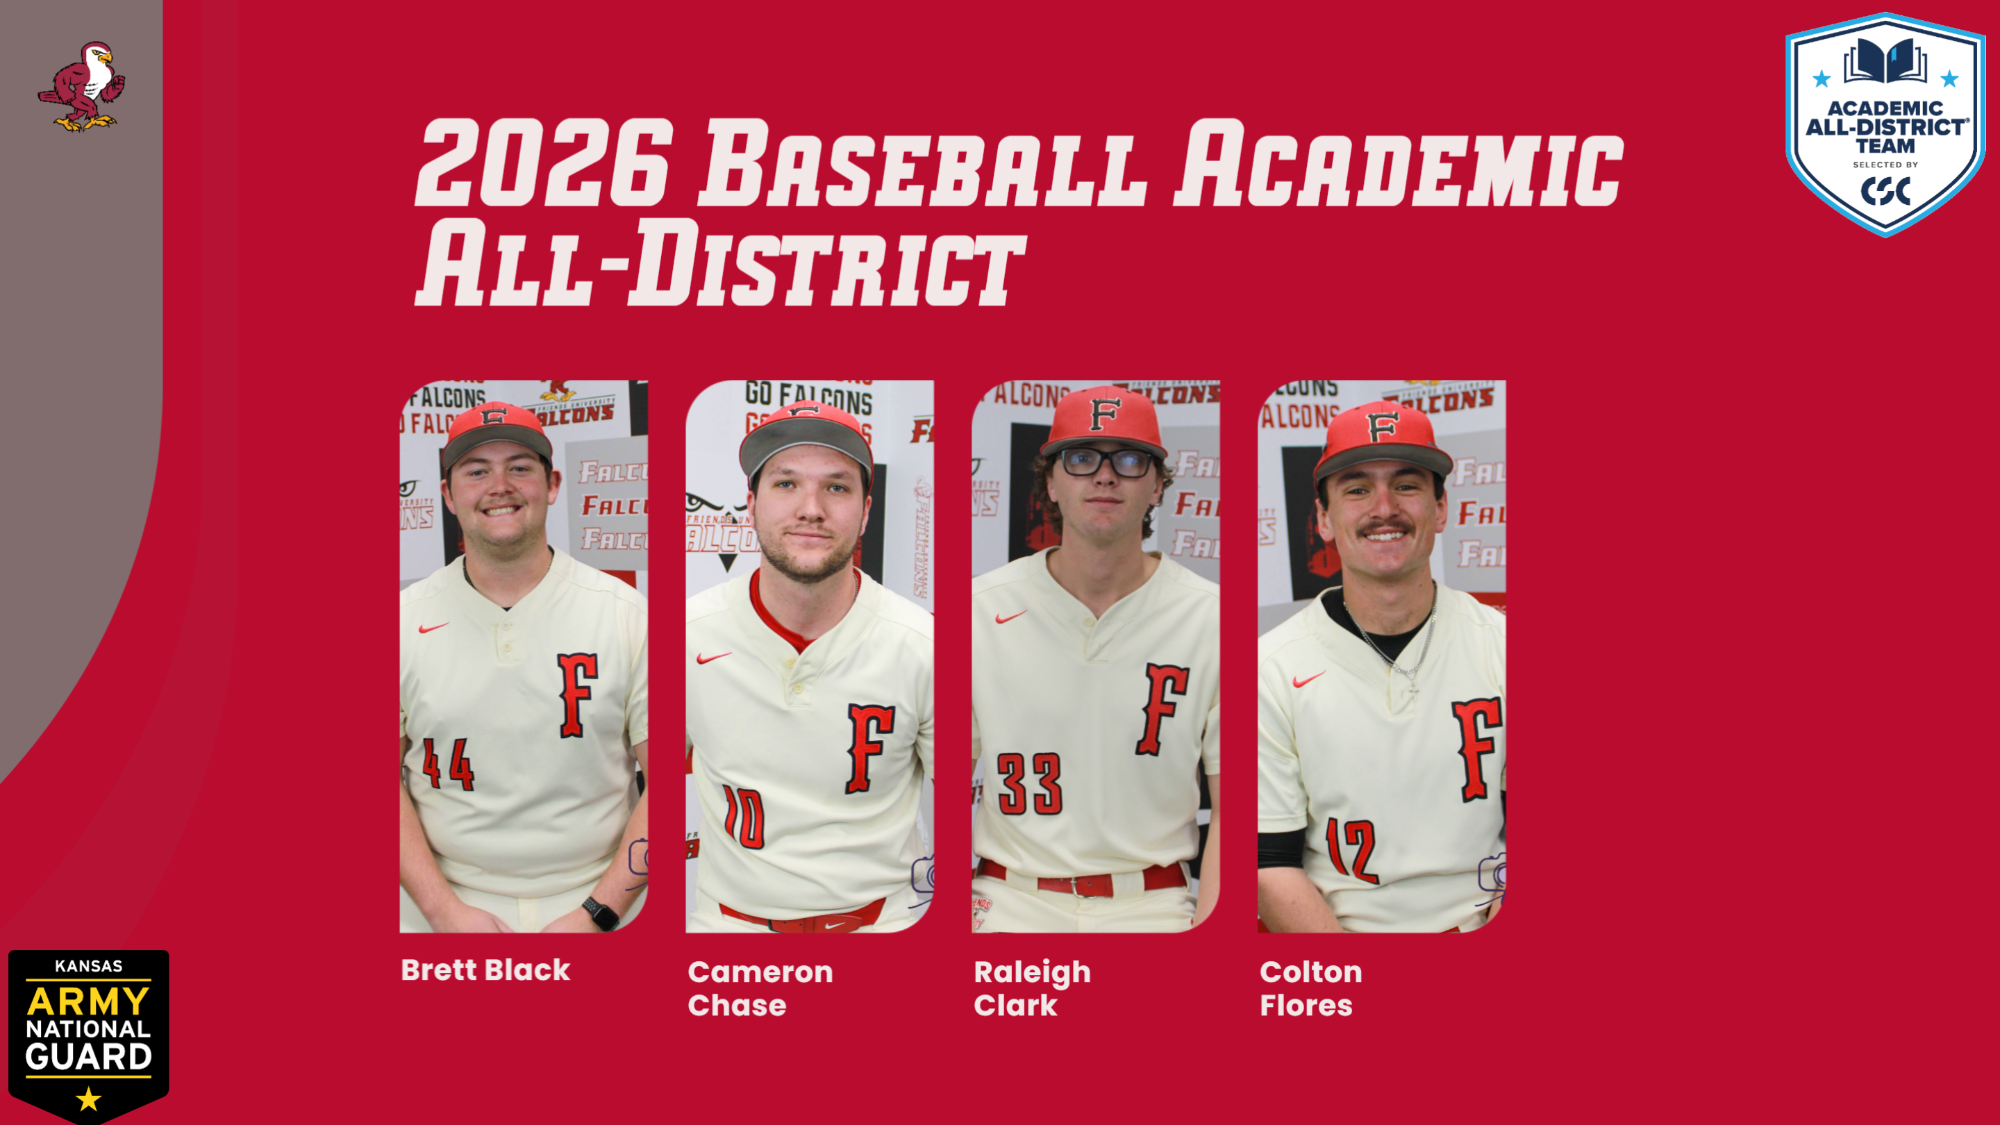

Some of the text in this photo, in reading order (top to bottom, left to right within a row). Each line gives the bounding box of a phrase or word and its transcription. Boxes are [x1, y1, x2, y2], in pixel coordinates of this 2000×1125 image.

[526, 404, 615, 427] ALCONS
[745, 380, 772, 405] GO
[980, 381, 1071, 408] ALCON
[1089, 397, 1122, 431] F
[1366, 411, 1399, 443] F
[686, 515, 732, 524] FRIENDS
[557, 652, 599, 739] F
[1135, 662, 1190, 757] F
[422, 737, 475, 791] 44
[845, 703, 896, 795] F
[1451, 696, 1503, 803] F
[997, 752, 1063, 815] 33
[722, 784, 765, 850] 10
[1326, 817, 1380, 885] 12
